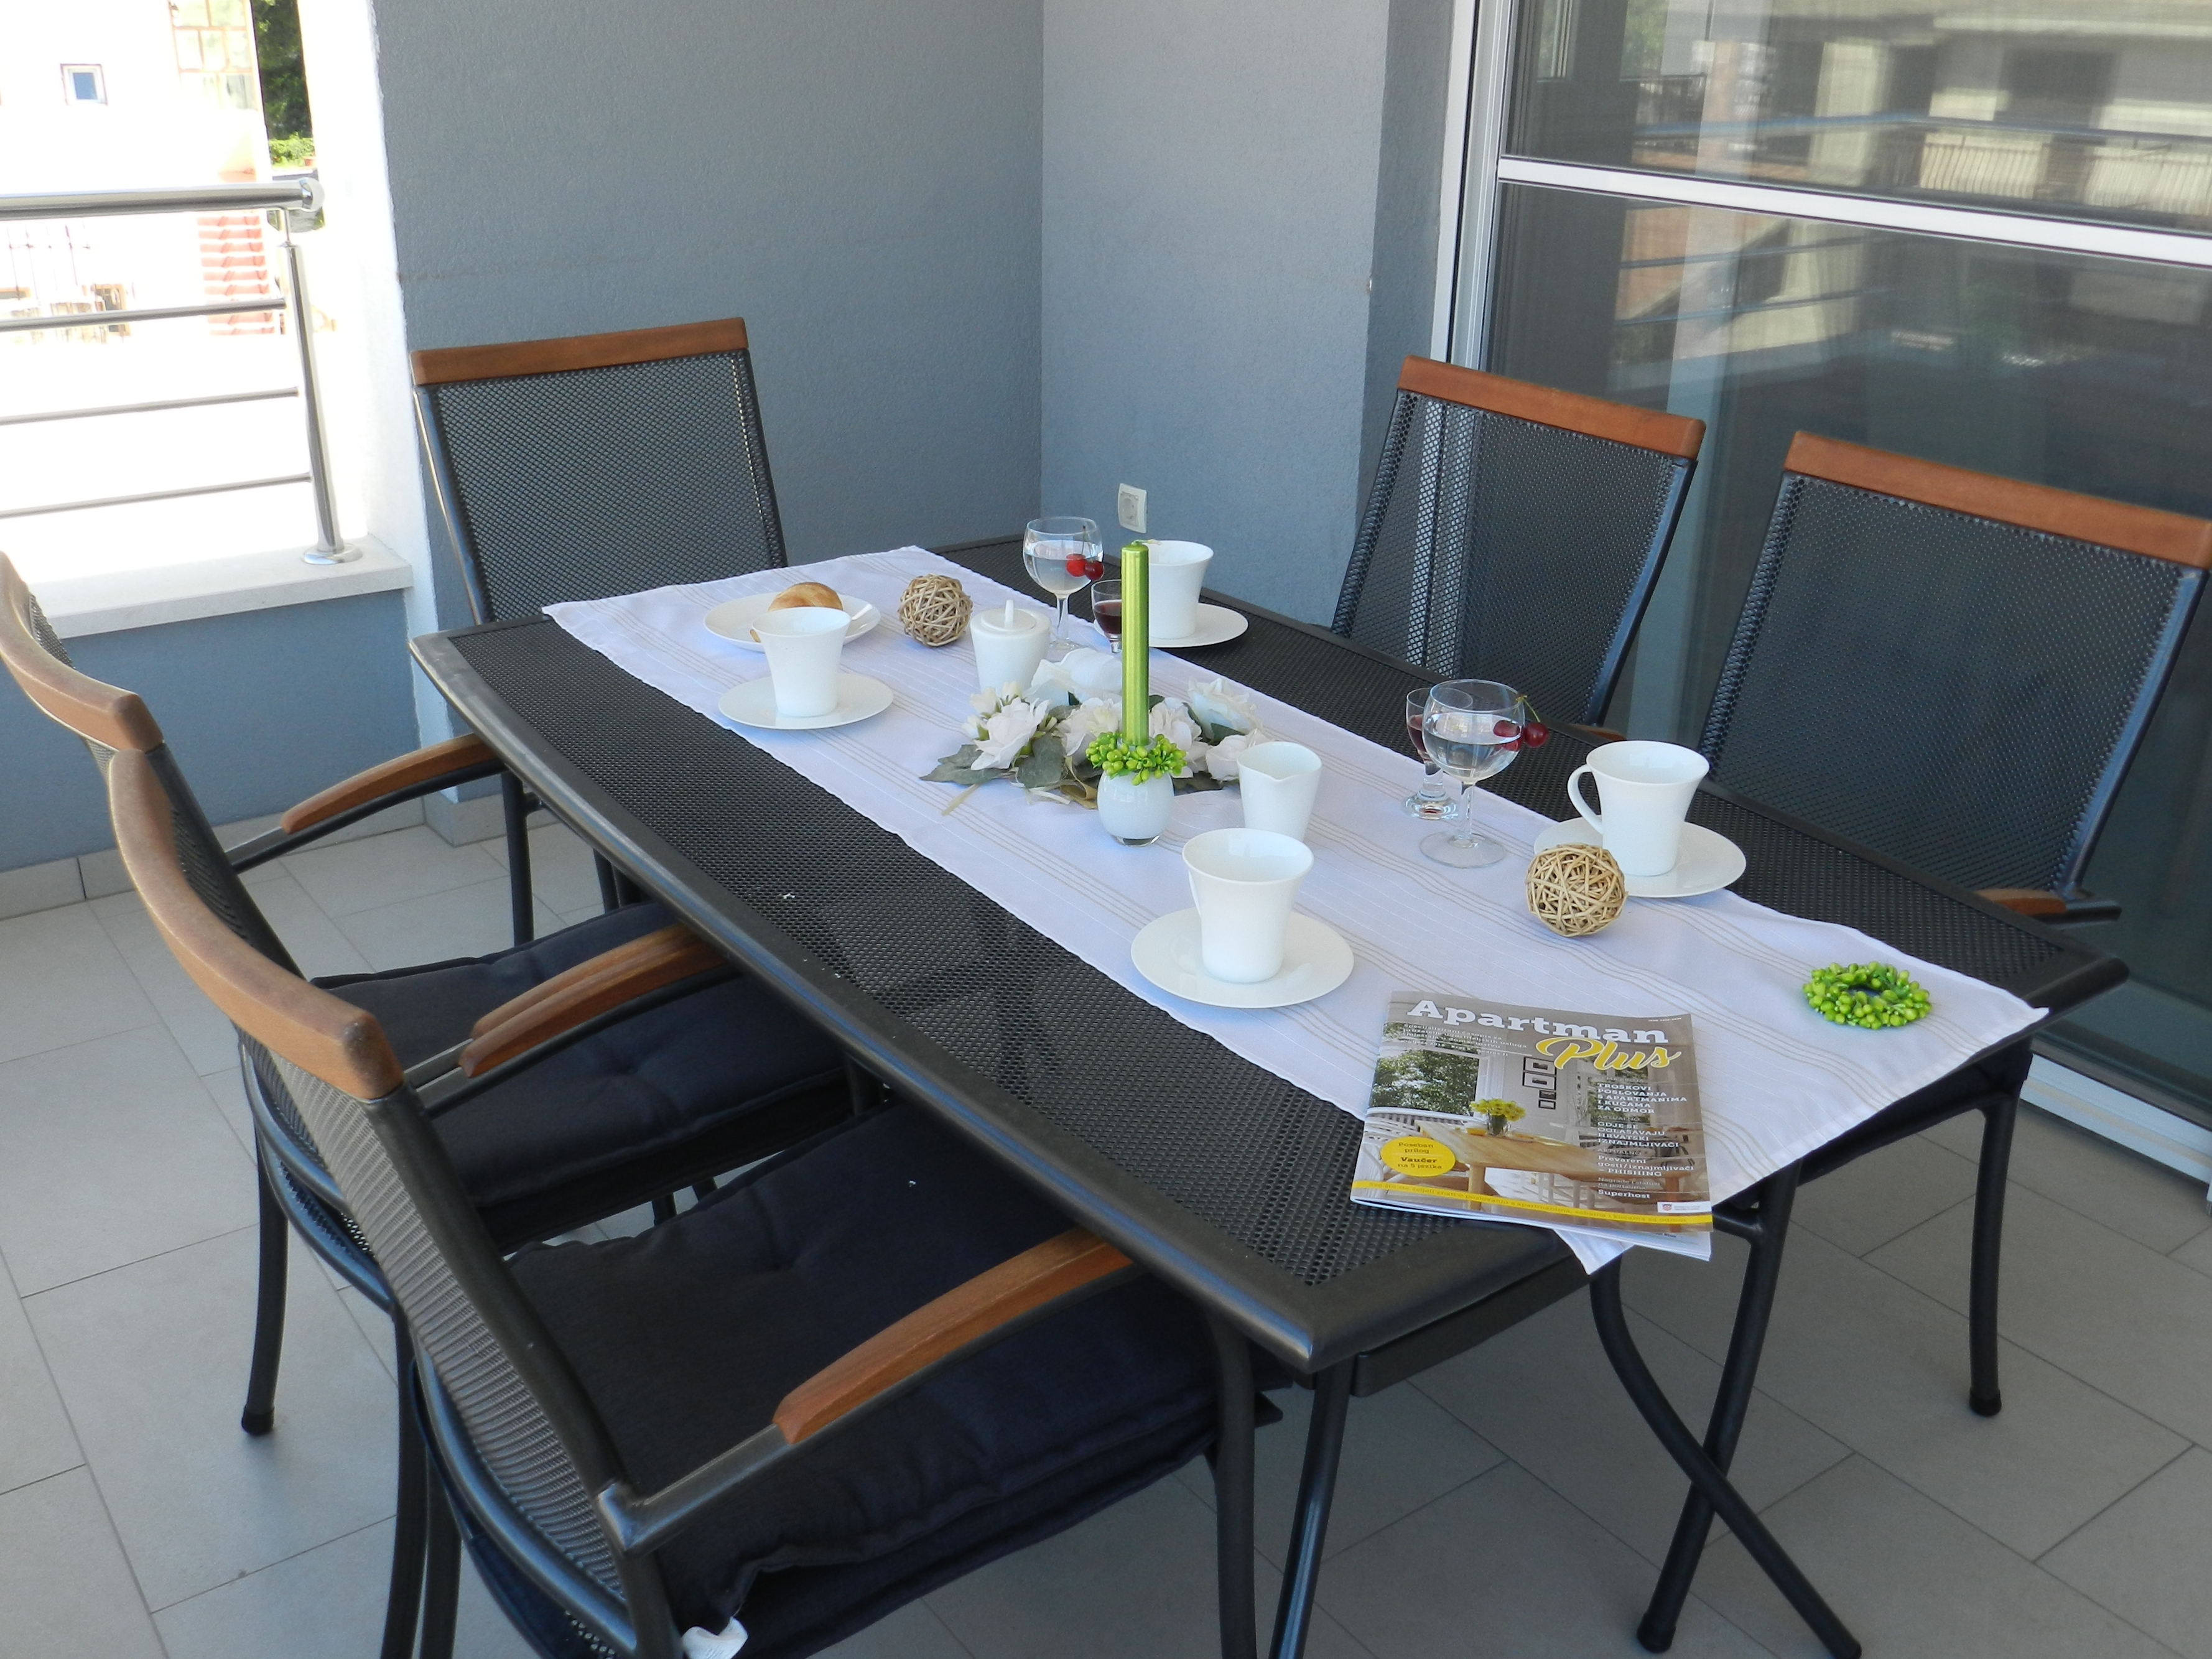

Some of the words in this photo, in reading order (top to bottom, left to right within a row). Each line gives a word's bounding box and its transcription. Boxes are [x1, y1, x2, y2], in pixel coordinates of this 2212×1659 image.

[1407, 1000, 1668, 1043] Apartman
[1536, 1036, 1682, 1070] Plus
[1597, 1089, 1667, 1097] POSLOVANJA
[1597, 1133, 1650, 1141] HRVATSKI
[1597, 1138, 1680, 1148] IZNAJMLJIVAČI
[1597, 1155, 1647, 1164] Prevareni
[1608, 1168, 1662, 1177] PHISHING
[1597, 1189, 1650, 1199] Superhost
